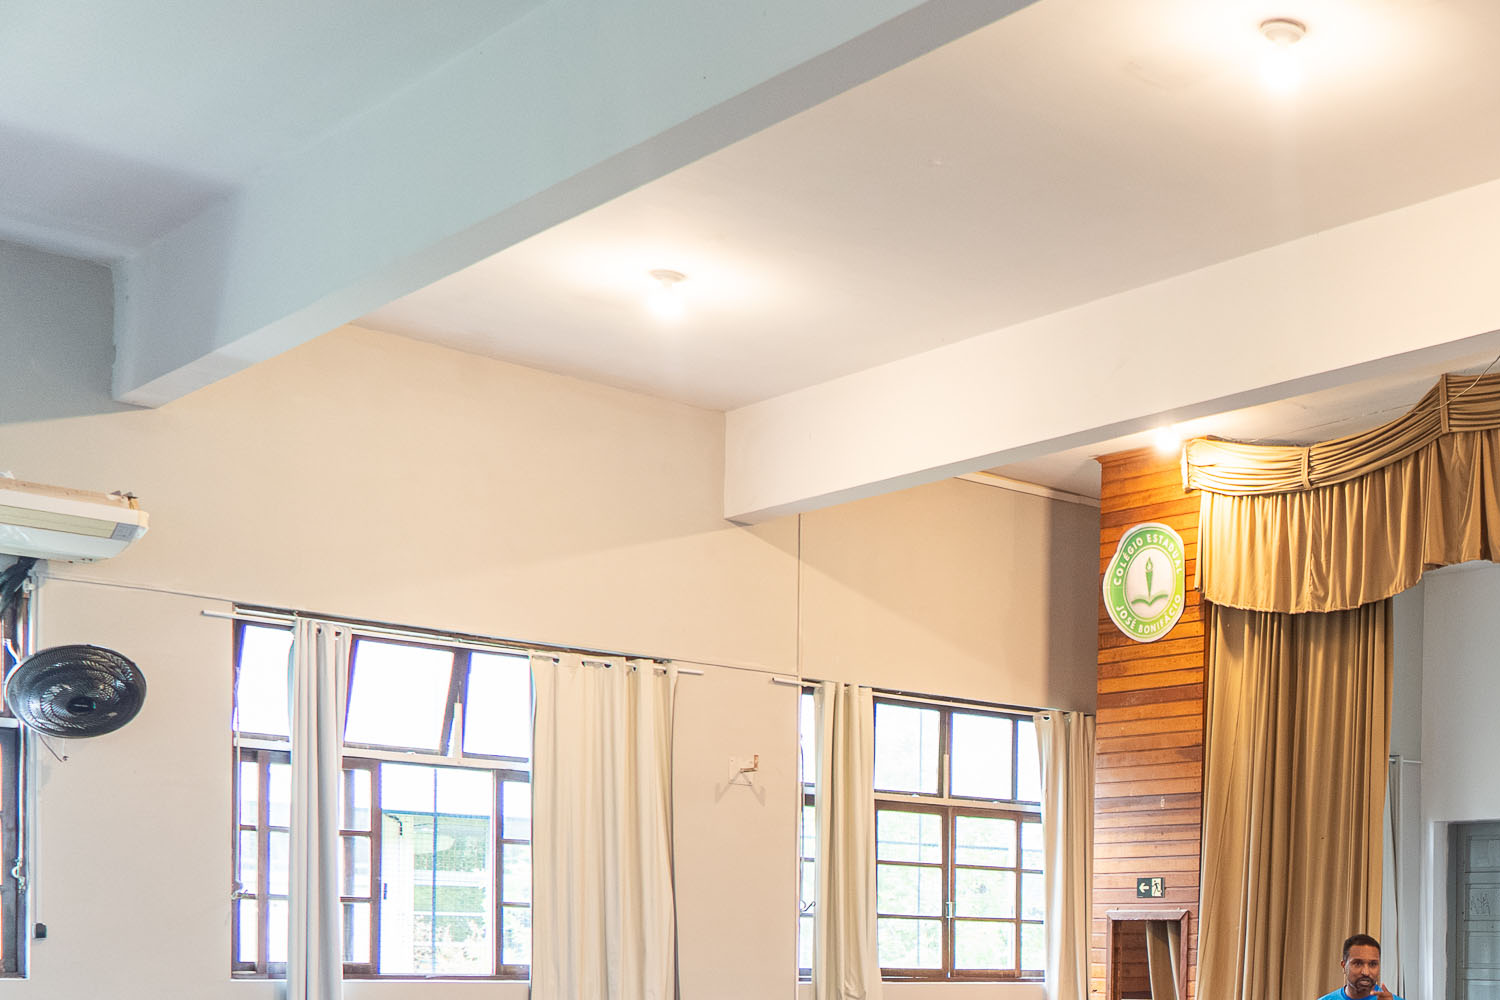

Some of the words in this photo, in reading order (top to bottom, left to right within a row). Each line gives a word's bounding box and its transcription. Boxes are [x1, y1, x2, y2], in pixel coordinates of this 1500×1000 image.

[1113, 537, 1144, 586] COLÉGIO
[1146, 533, 1182, 575] ESTADUAL
[1116, 605, 1137, 630] JOSÉ
[1138, 594, 1181, 634] BONIFÁCIO
